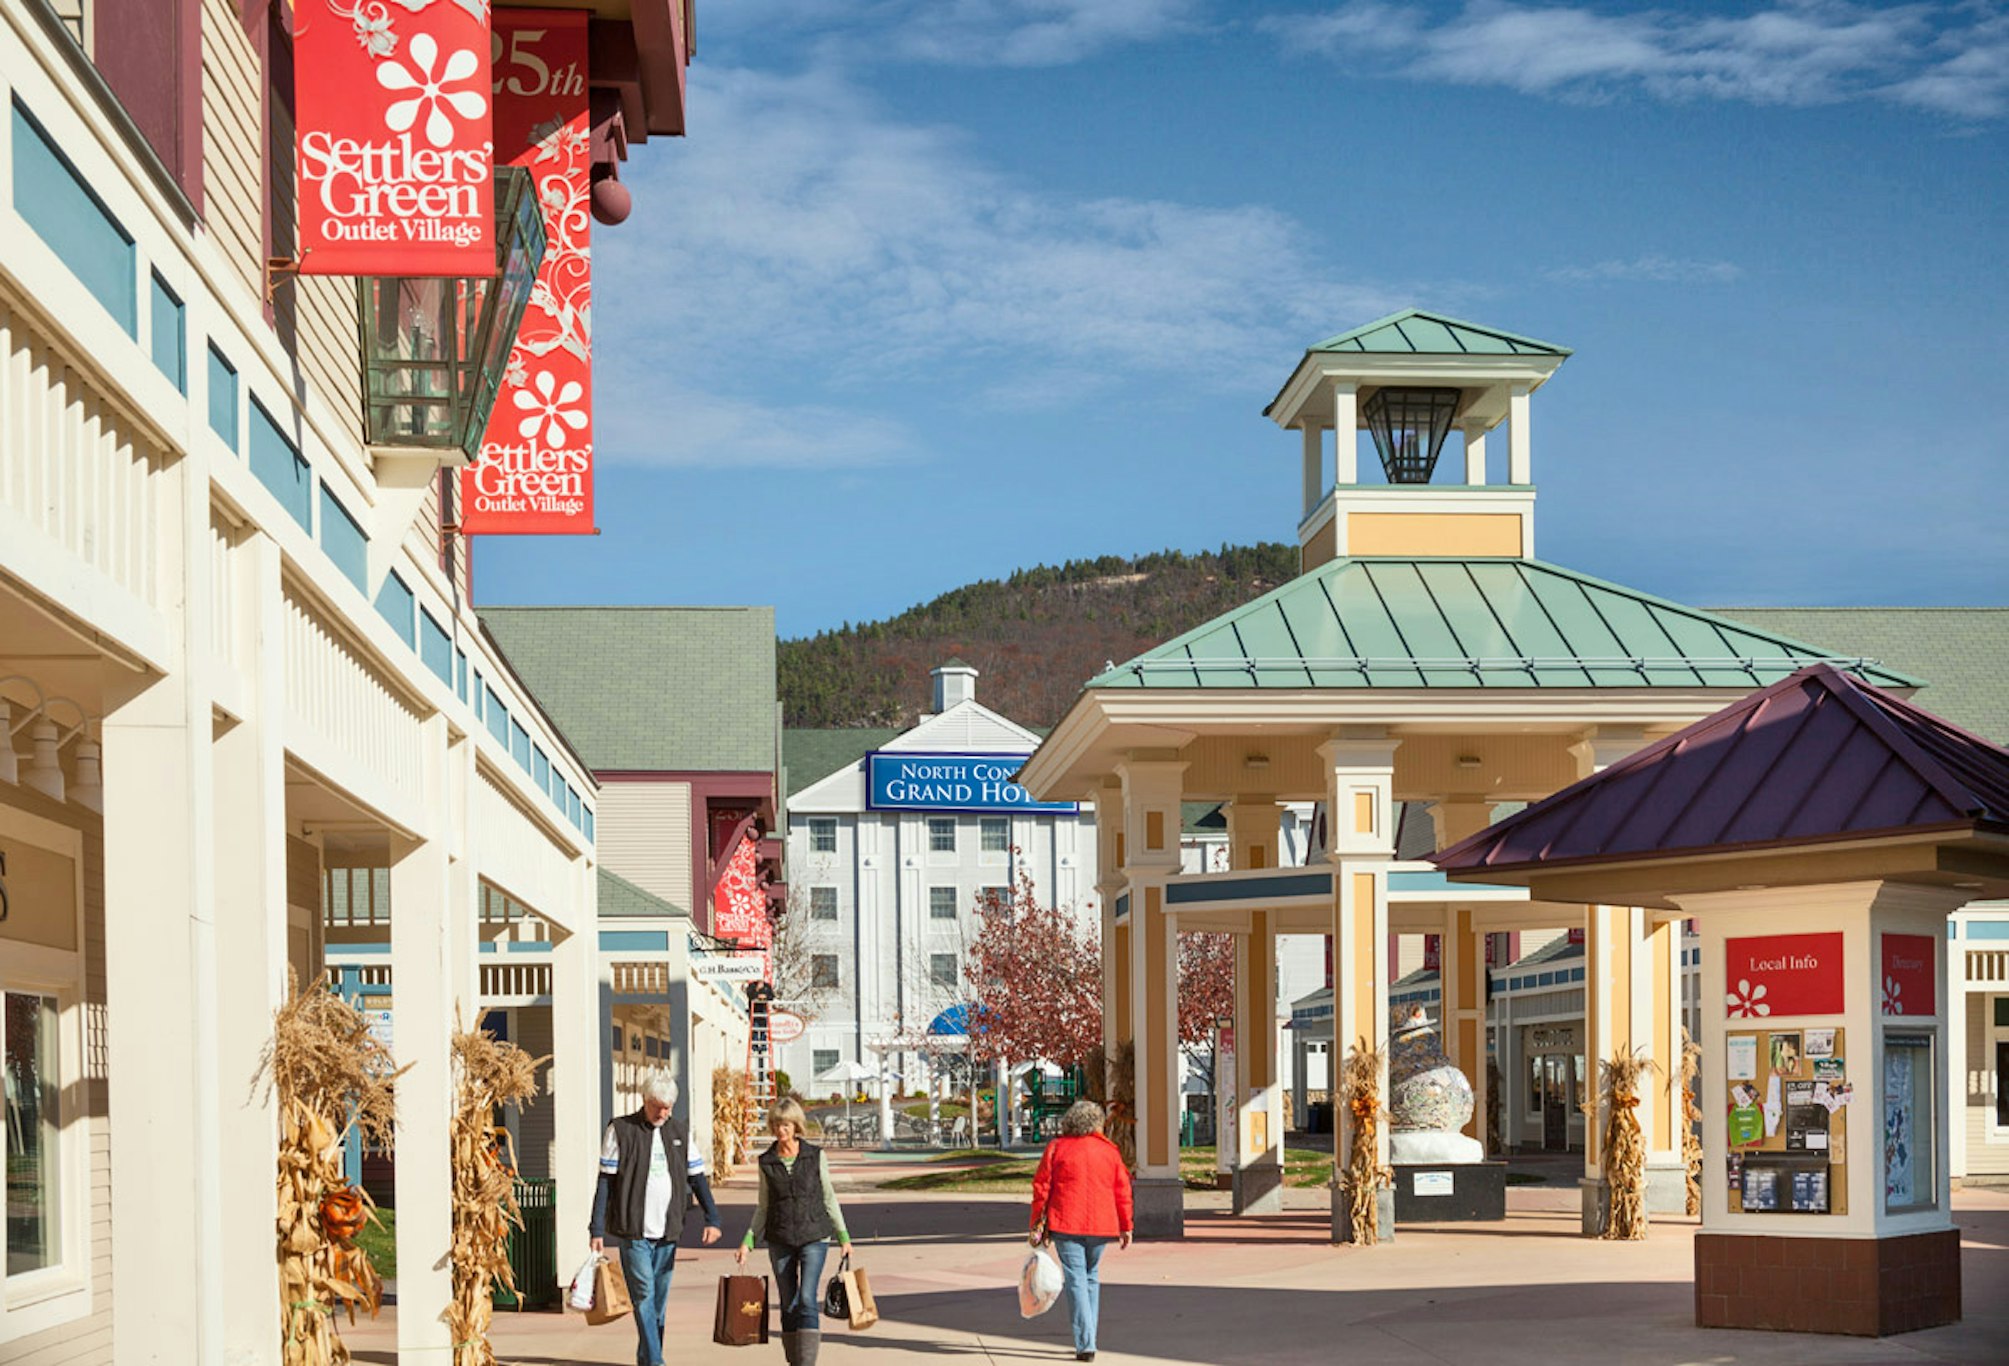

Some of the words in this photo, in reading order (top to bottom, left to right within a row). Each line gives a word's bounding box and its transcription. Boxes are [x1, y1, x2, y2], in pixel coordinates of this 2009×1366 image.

[302, 131, 494, 184] Settlers'
[320, 169, 482, 218] Green
[321, 217, 398, 241] Outlet
[400, 218, 482, 248] Village
[475, 464, 585, 496] Green
[475, 496, 527, 513] Outlet
[527, 497, 584, 517] Village
[901, 763, 966, 780] NORTH
[973, 764, 1020, 781] CON
[886, 779, 972, 802] GRAND
[1750, 956, 1786, 973] Local
[1790, 954, 1818, 970] Info
